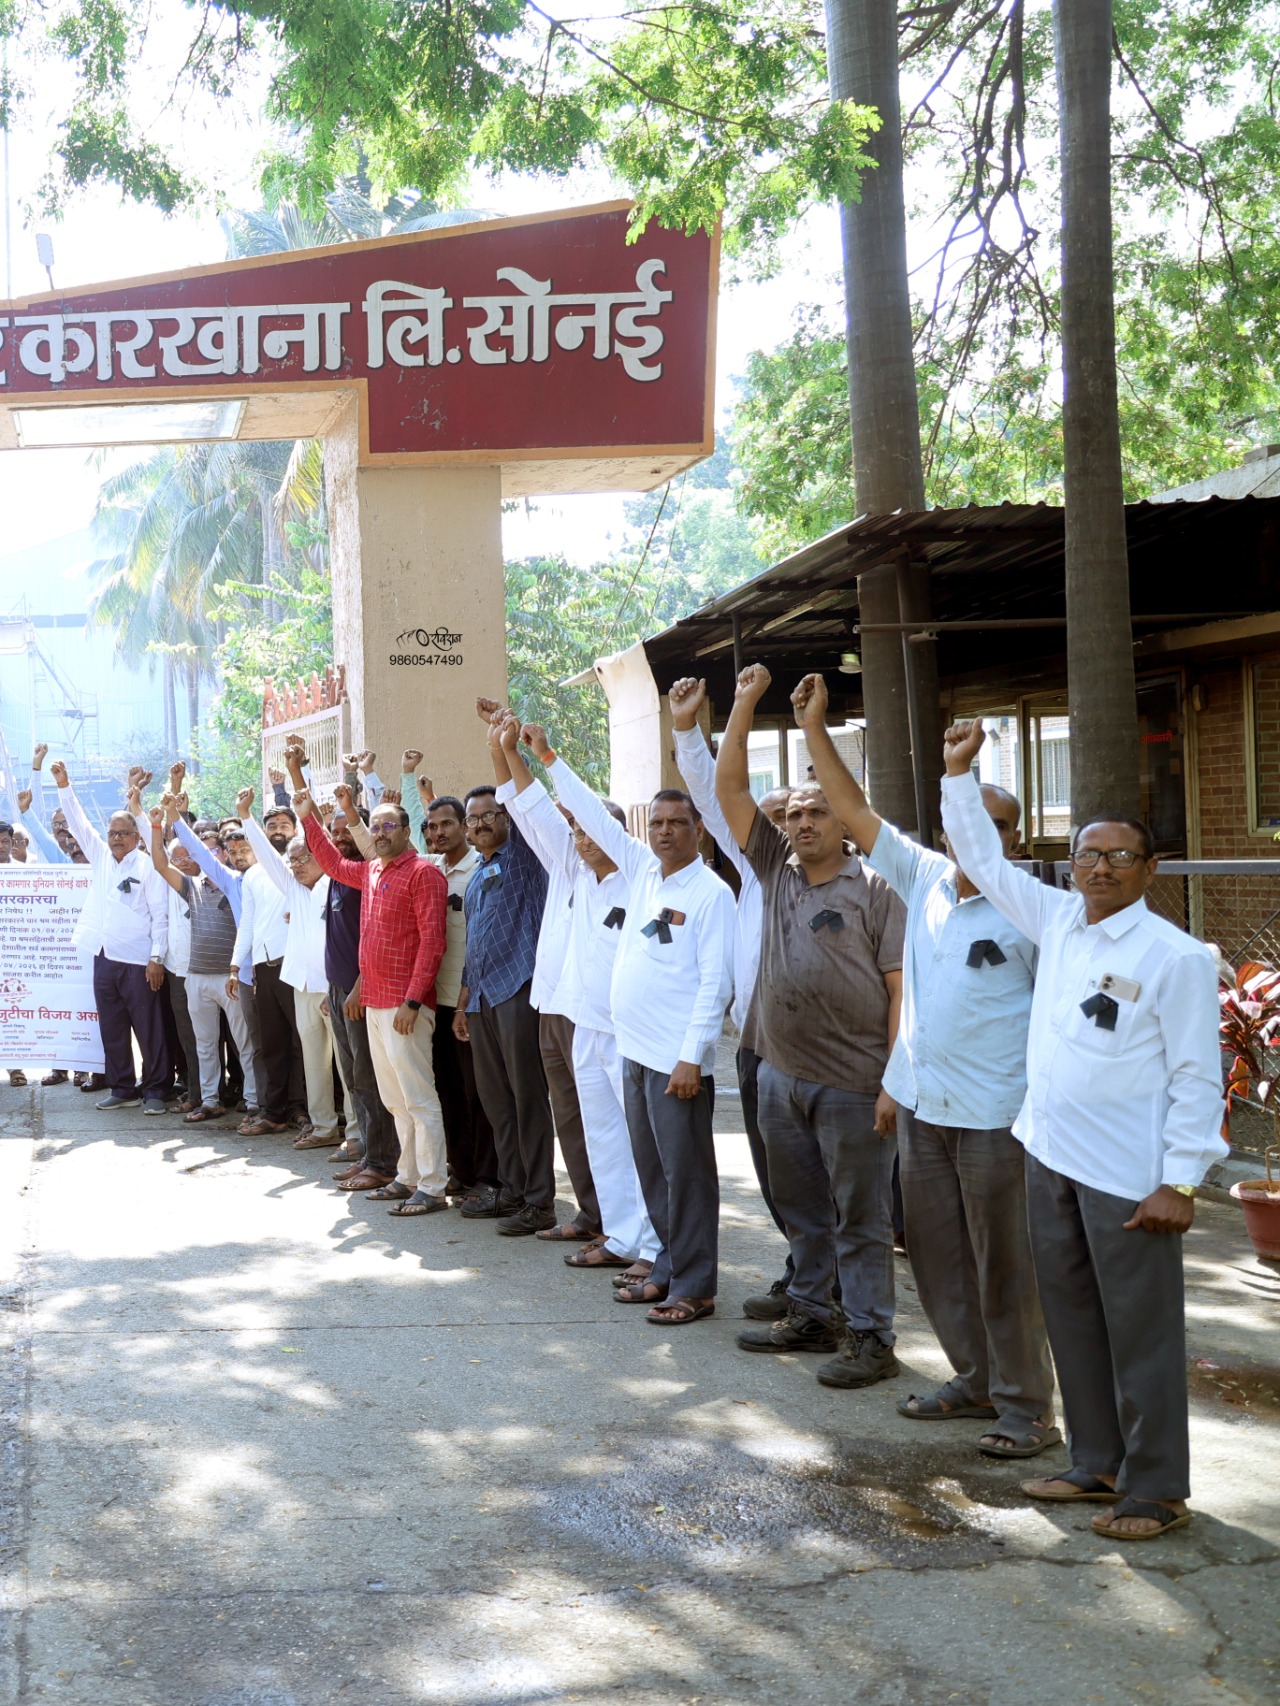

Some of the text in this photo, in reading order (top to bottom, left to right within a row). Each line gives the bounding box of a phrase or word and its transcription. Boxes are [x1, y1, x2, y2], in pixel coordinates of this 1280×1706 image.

[14, 302, 350, 382] कारखाना
[6, 879, 31, 889] कामगार
[38, 1006, 72, 1020] विजय
[76, 1011, 99, 1022] अस
